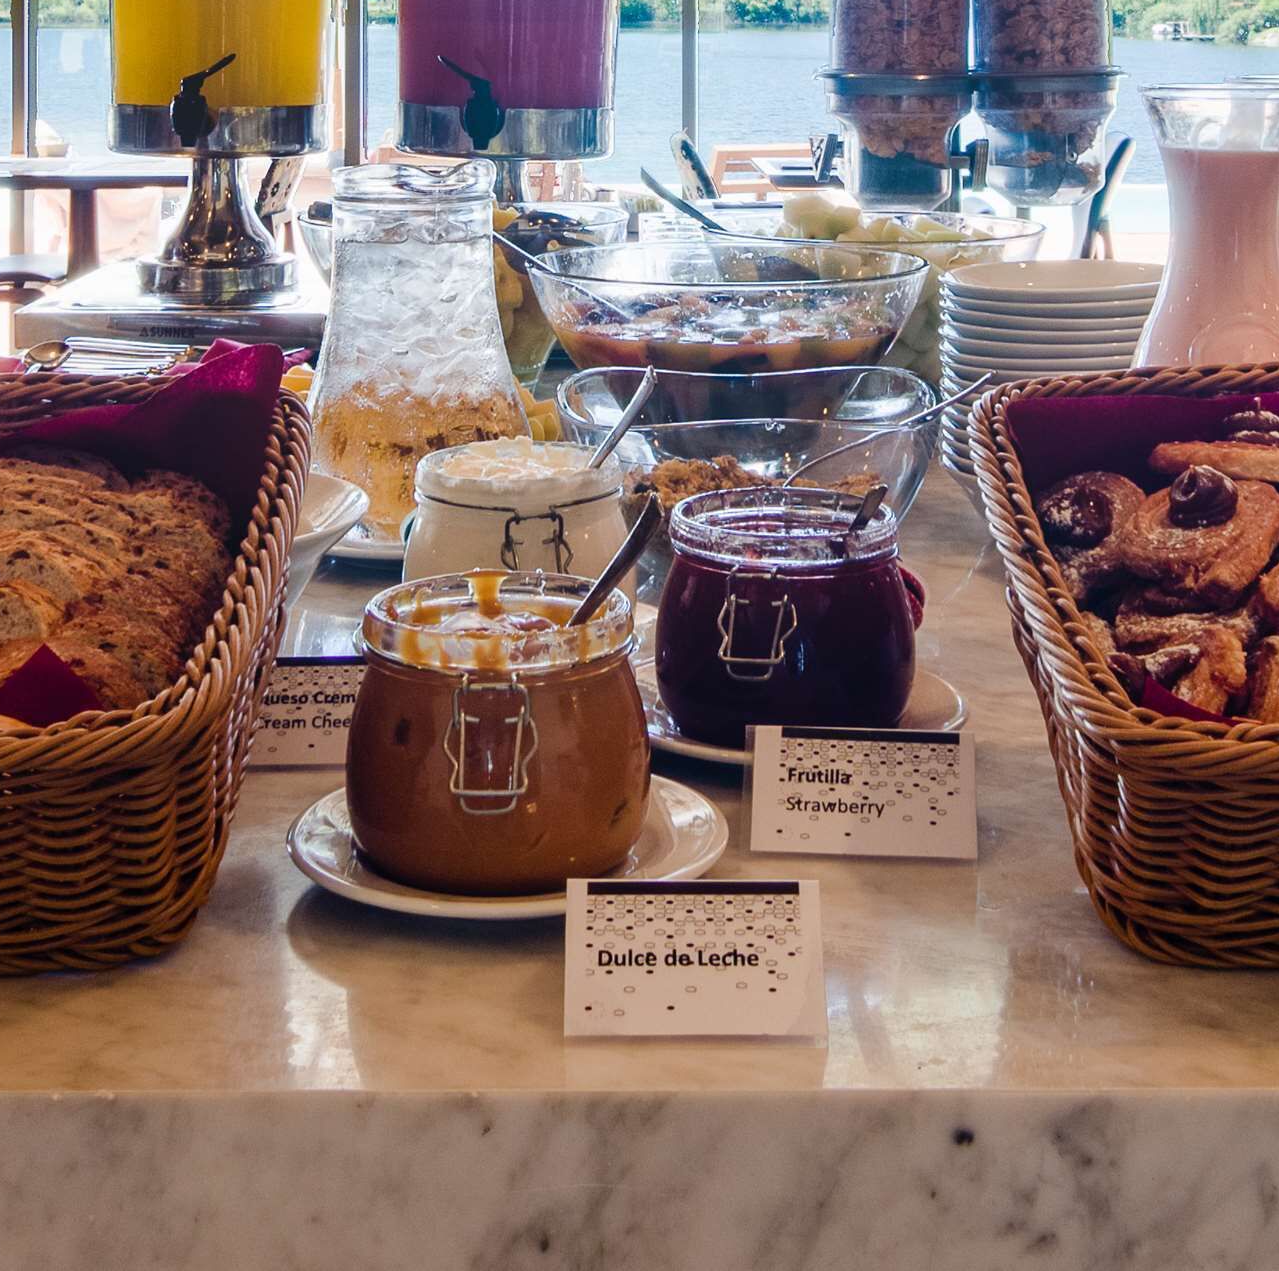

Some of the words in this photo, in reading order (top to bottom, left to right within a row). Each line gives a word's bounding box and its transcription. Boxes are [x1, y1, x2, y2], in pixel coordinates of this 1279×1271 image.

[312, 691, 357, 704] Crem
[311, 715, 352, 729] Chee
[787, 768, 852, 785] Frutilla
[786, 796, 885, 818] Strawberry
[598, 949, 658, 967] Dulce
[664, 949, 693, 967] de
[697, 949, 760, 967] Leche
